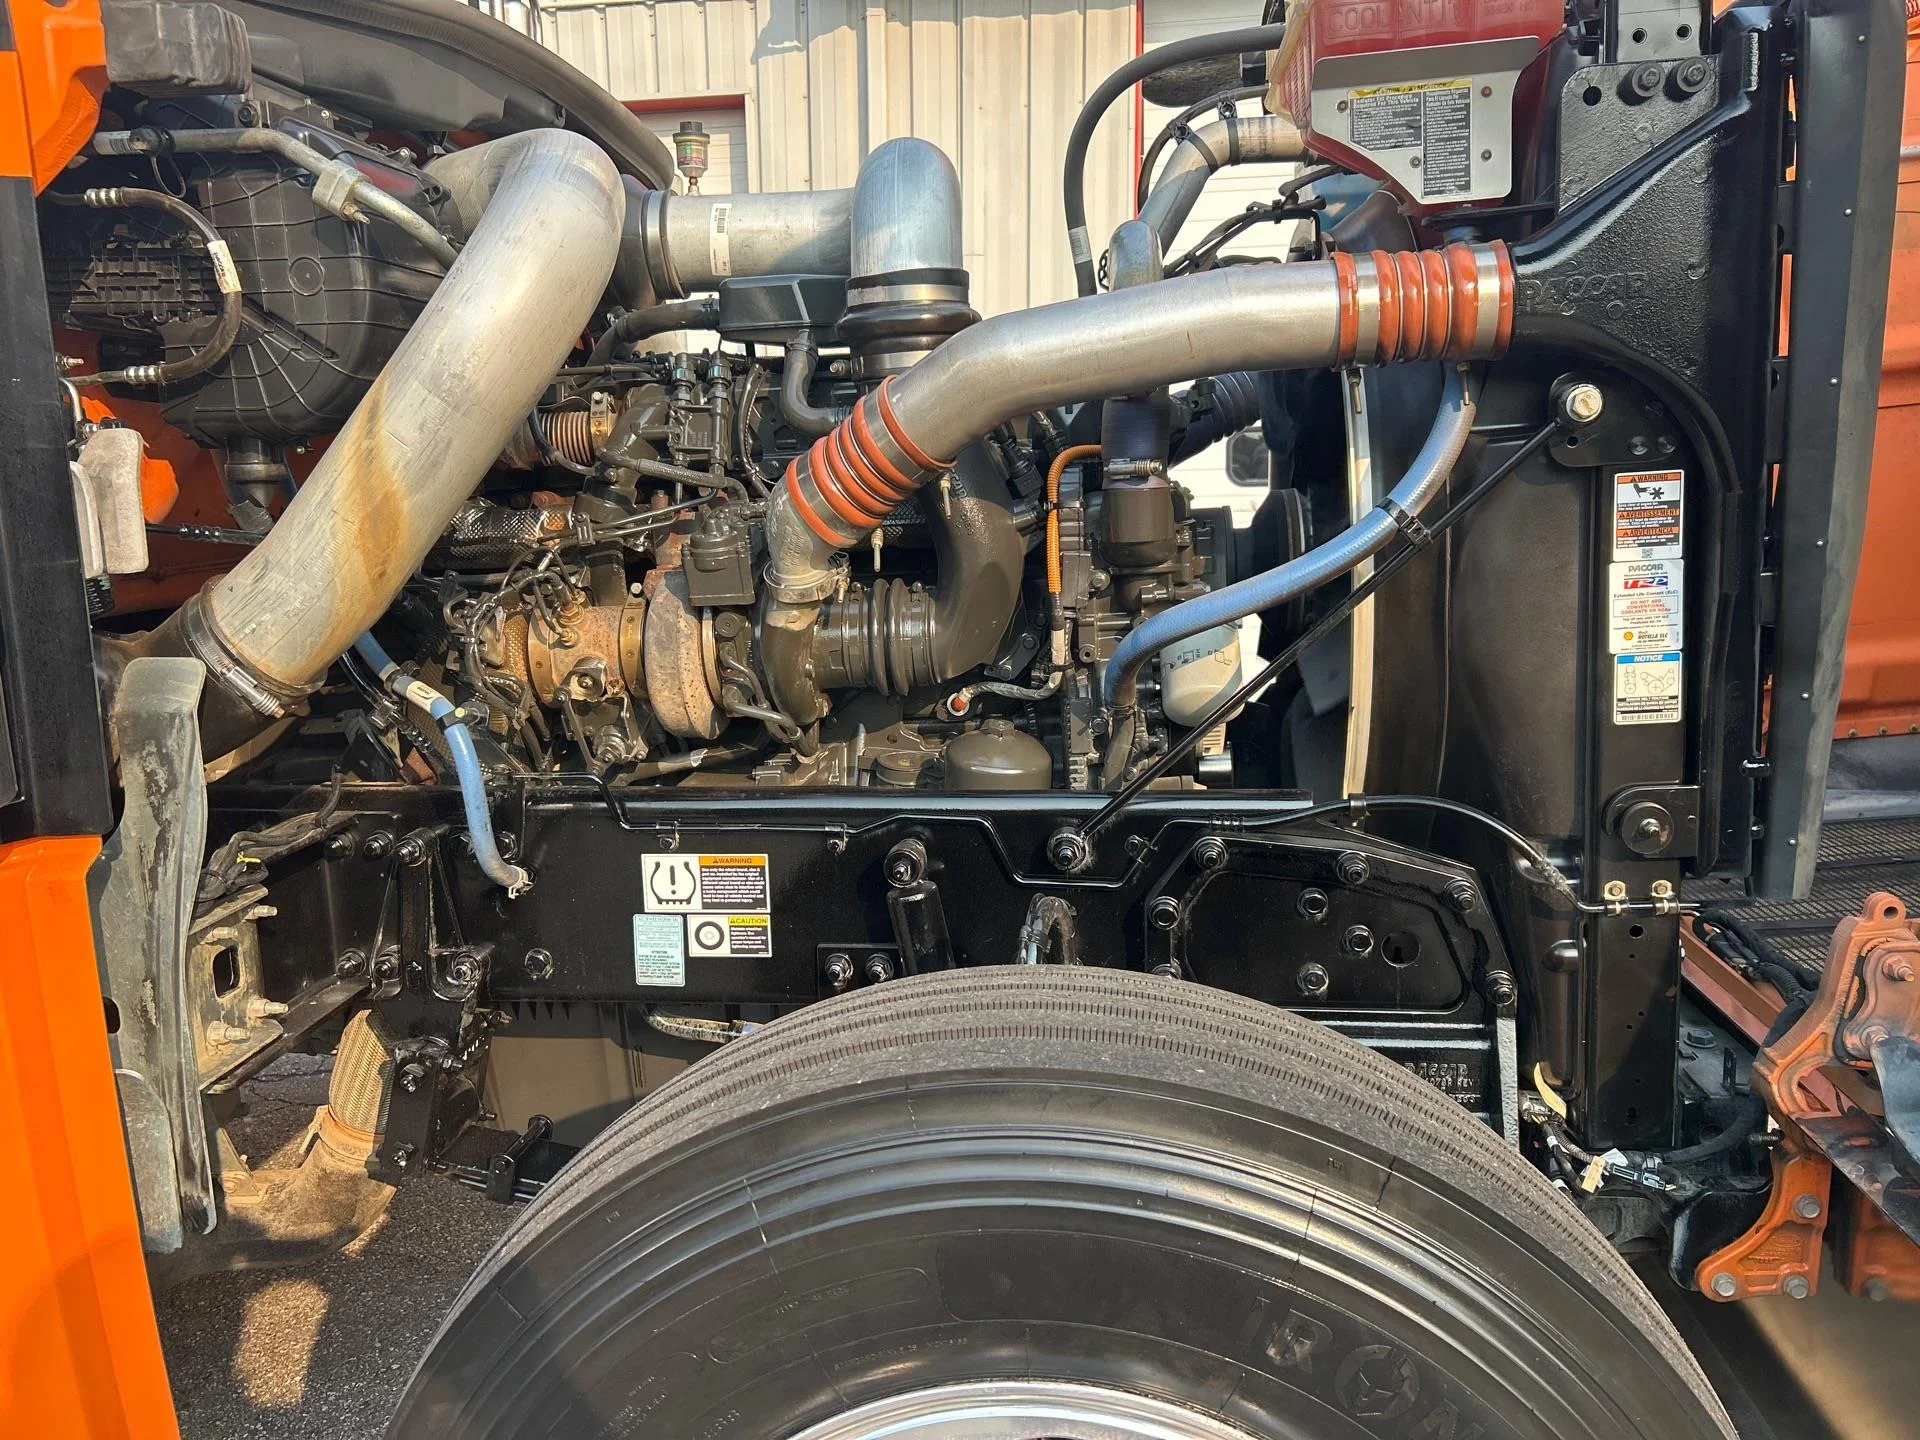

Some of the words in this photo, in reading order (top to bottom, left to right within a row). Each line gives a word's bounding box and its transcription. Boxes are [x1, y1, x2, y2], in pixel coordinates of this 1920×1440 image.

[1638, 473, 1669, 481] WARNING
[1626, 509, 1679, 518] AVERTISSEMENT
[1630, 527, 1673, 536] ADVERTENCIA
[1628, 564, 1664, 572] PACCAR
